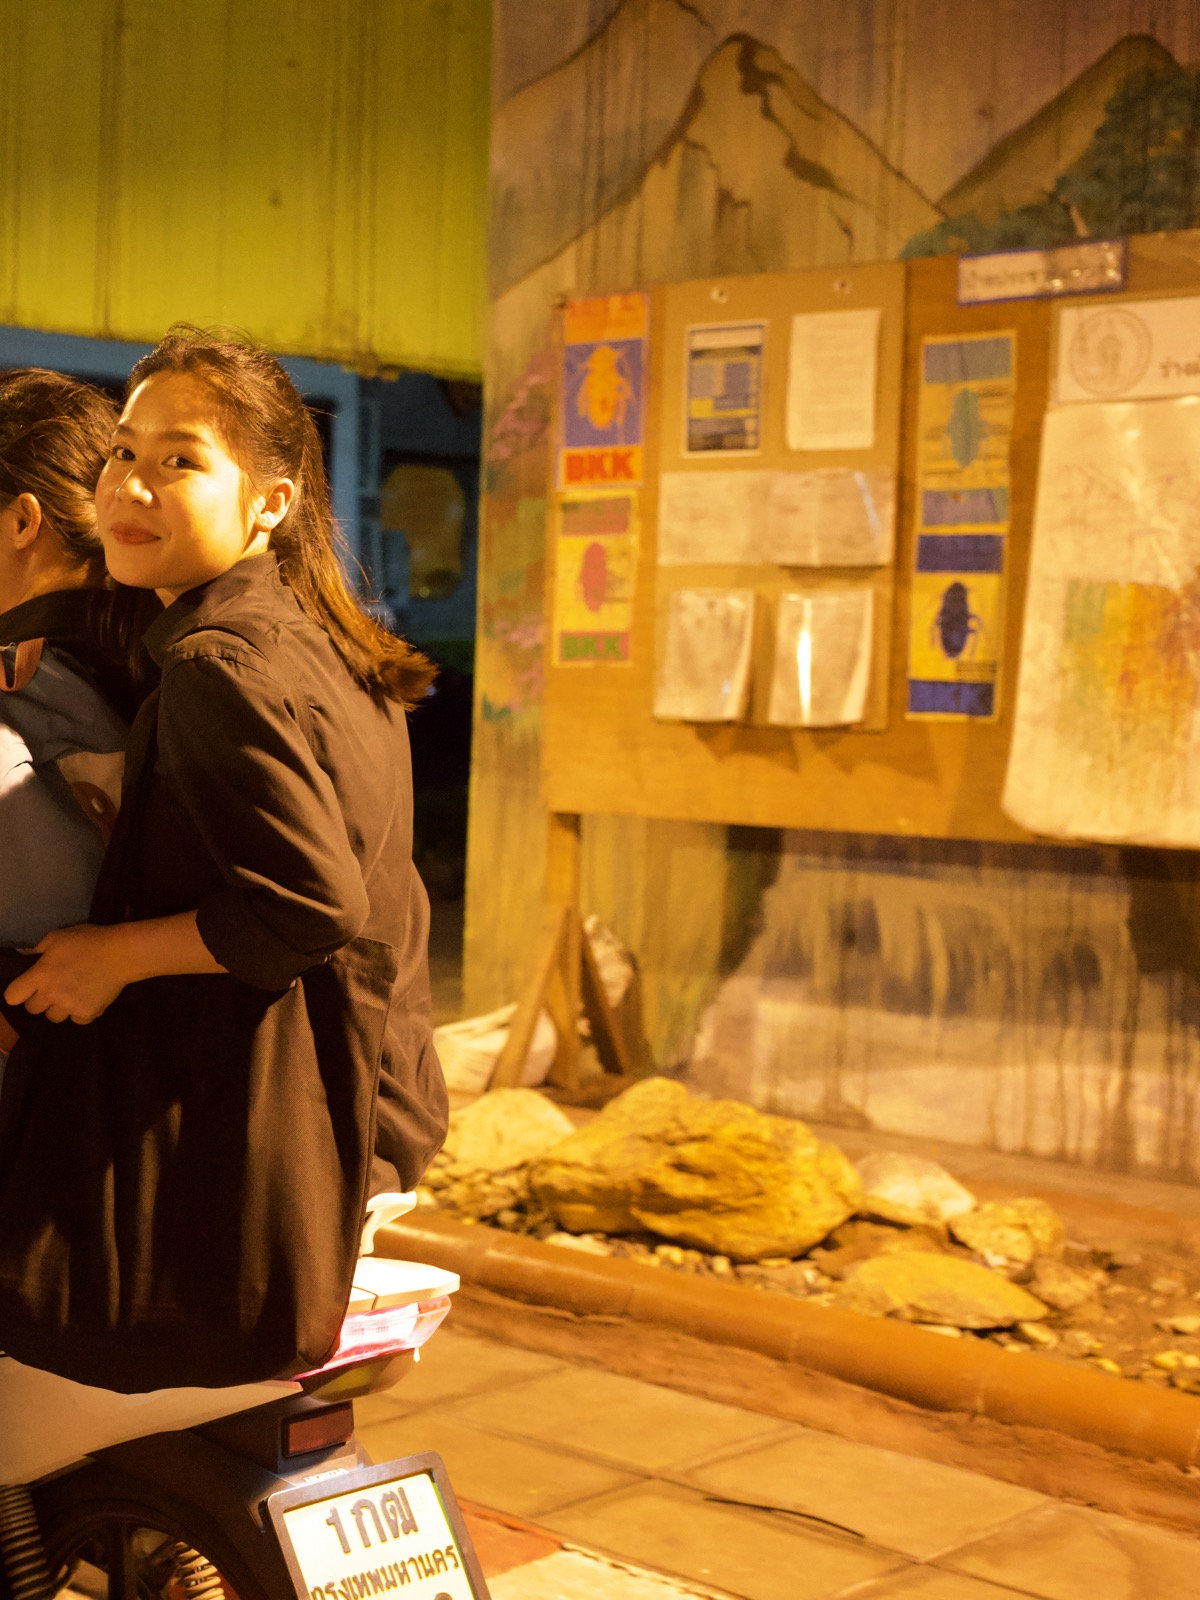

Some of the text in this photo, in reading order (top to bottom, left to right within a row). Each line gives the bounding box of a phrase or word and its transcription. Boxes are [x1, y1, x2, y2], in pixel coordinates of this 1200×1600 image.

[566, 452, 635, 482] BKK
[310, 1544, 460, 1600] กรงเทพมหานคร
